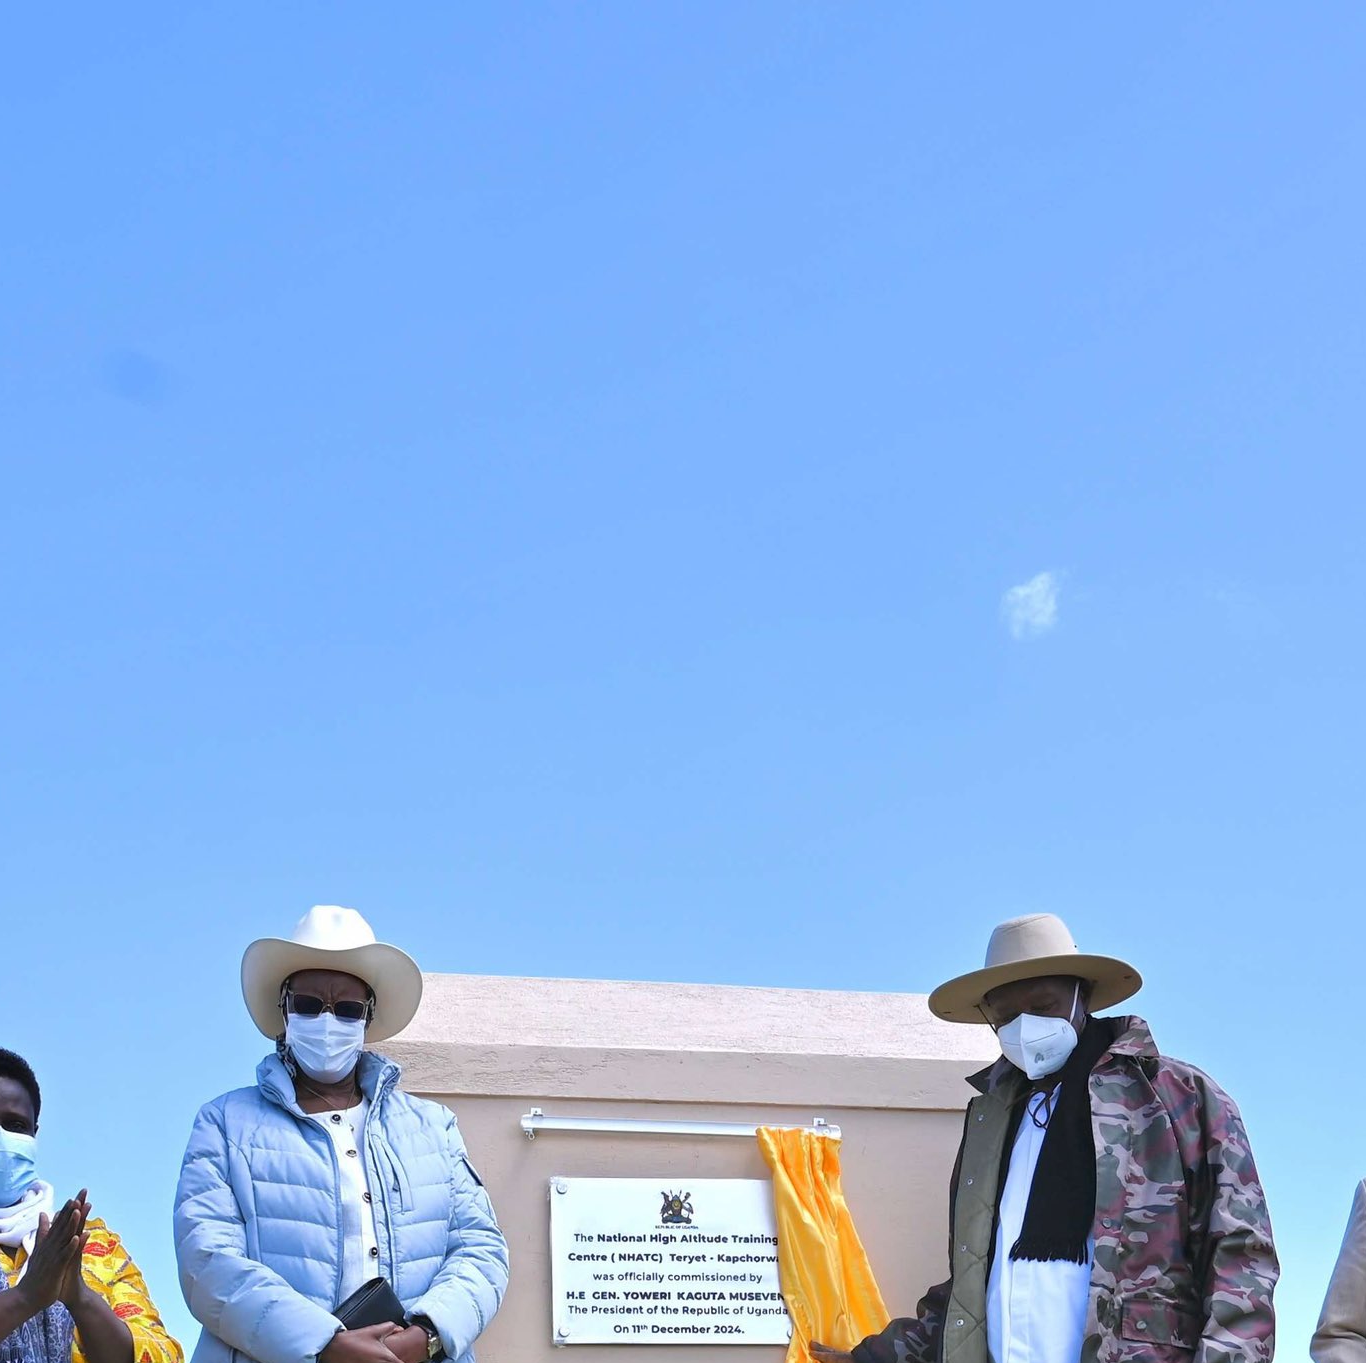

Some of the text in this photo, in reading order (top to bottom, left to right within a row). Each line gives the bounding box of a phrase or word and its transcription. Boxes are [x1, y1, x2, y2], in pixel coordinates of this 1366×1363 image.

[573, 1233, 778, 1246] The National High Altitude Training
[567, 1253, 608, 1262] Centre
[618, 1254, 663, 1264] NHATC)
[669, 1254, 707, 1265] Teryet
[617, 1272, 665, 1284] officially
[667, 1273, 747, 1282] commissioned
[749, 1274, 763, 1284] by
[566, 1292, 785, 1301] H.E GEN. YOWERI KAGUTA MUSEVEN
[567, 1306, 788, 1317] The President of the Republic of Uganda
[613, 1325, 630, 1334] On
[651, 1325, 711, 1334] December
[713, 1325, 745, 1334] 2024.
